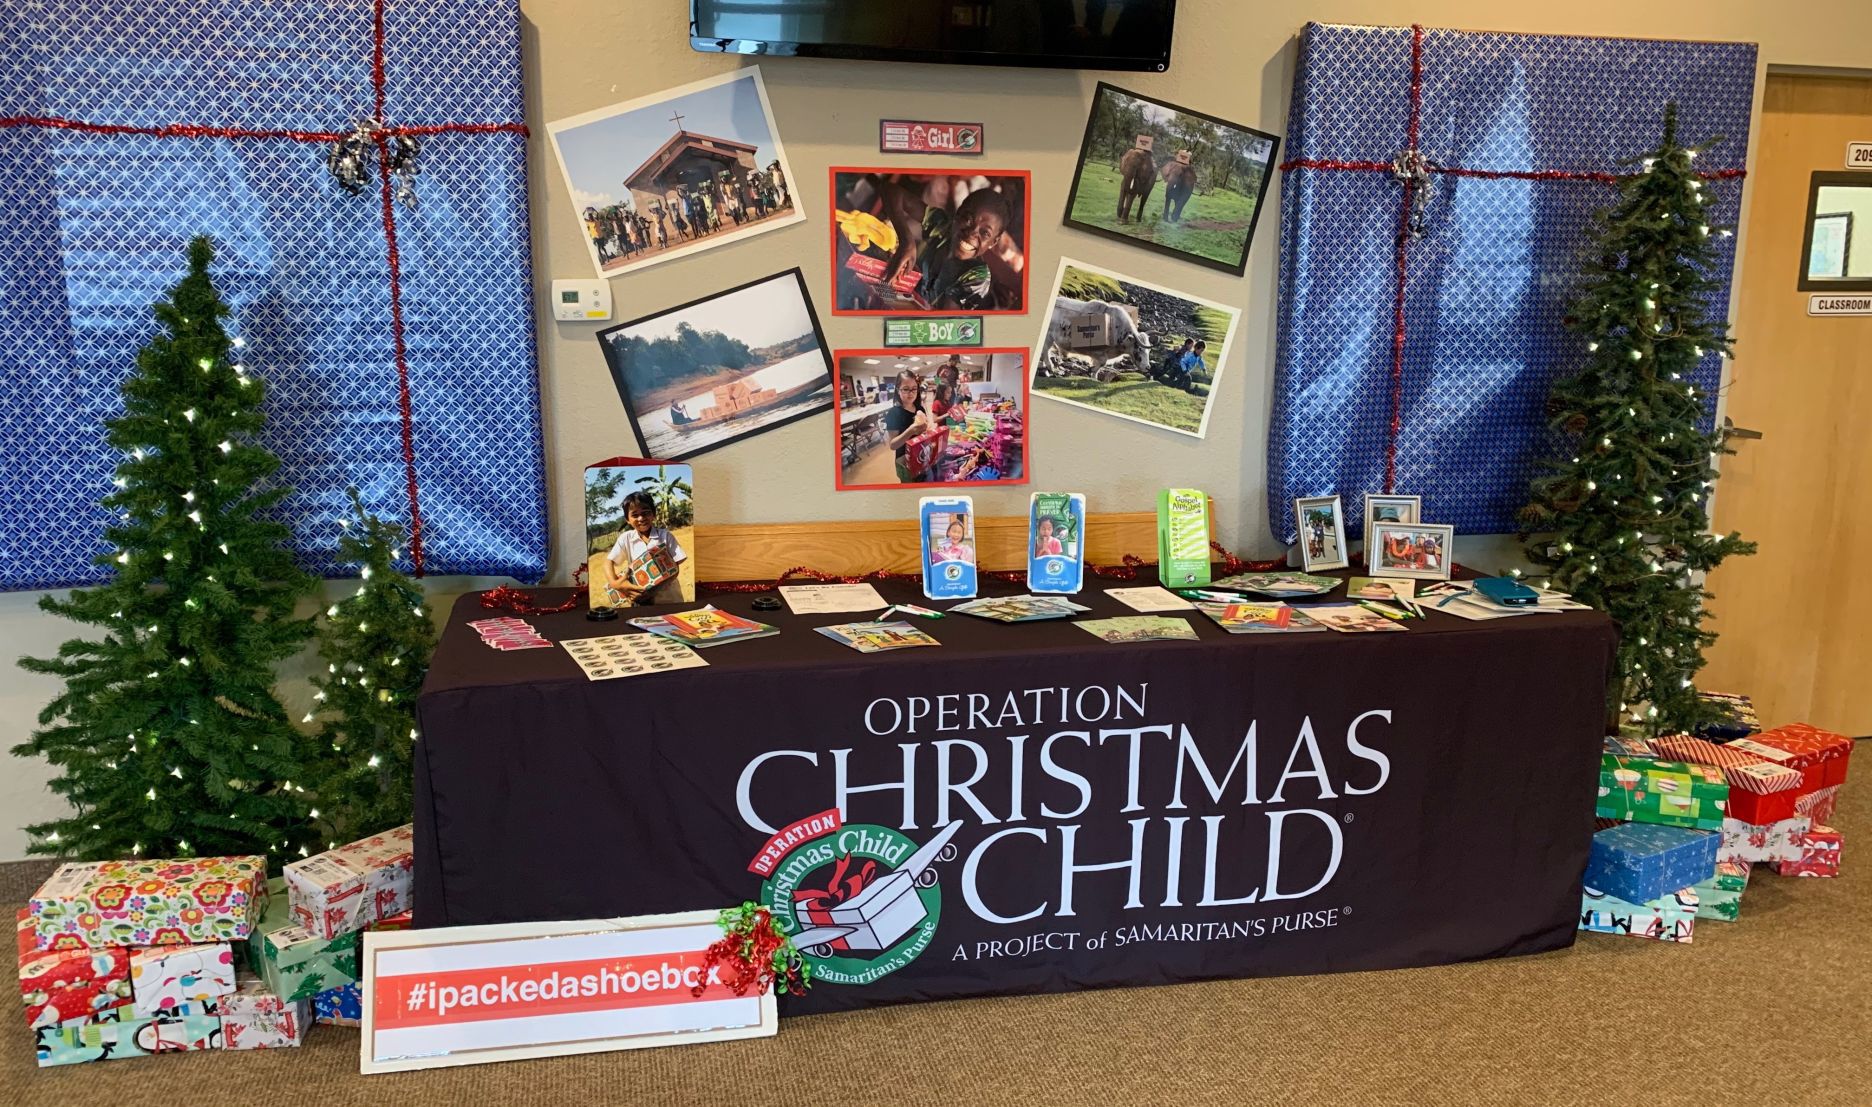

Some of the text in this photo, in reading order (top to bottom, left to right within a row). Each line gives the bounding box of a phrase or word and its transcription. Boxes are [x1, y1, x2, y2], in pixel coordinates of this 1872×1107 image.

[928, 127, 955, 149] Girl
[929, 322, 954, 342] BOY
[1818, 299, 1871, 310] CLASSROOM
[864, 682, 1148, 736] OPERATION
[735, 709, 1393, 832] CHRISTMAS
[754, 815, 836, 872] OPERATION
[961, 809, 1344, 924] CHILD
[772, 830, 908, 933] Christmas Child
[815, 922, 936, 984] Samaritan's Purse
[951, 944, 966, 961] A
[974, 932, 1082, 959] PROJECT
[1086, 930, 1107, 950] of
[1115, 919, 1266, 947] SAMARITAN'S
[407, 961, 721, 1016] #ipackedashoebox
